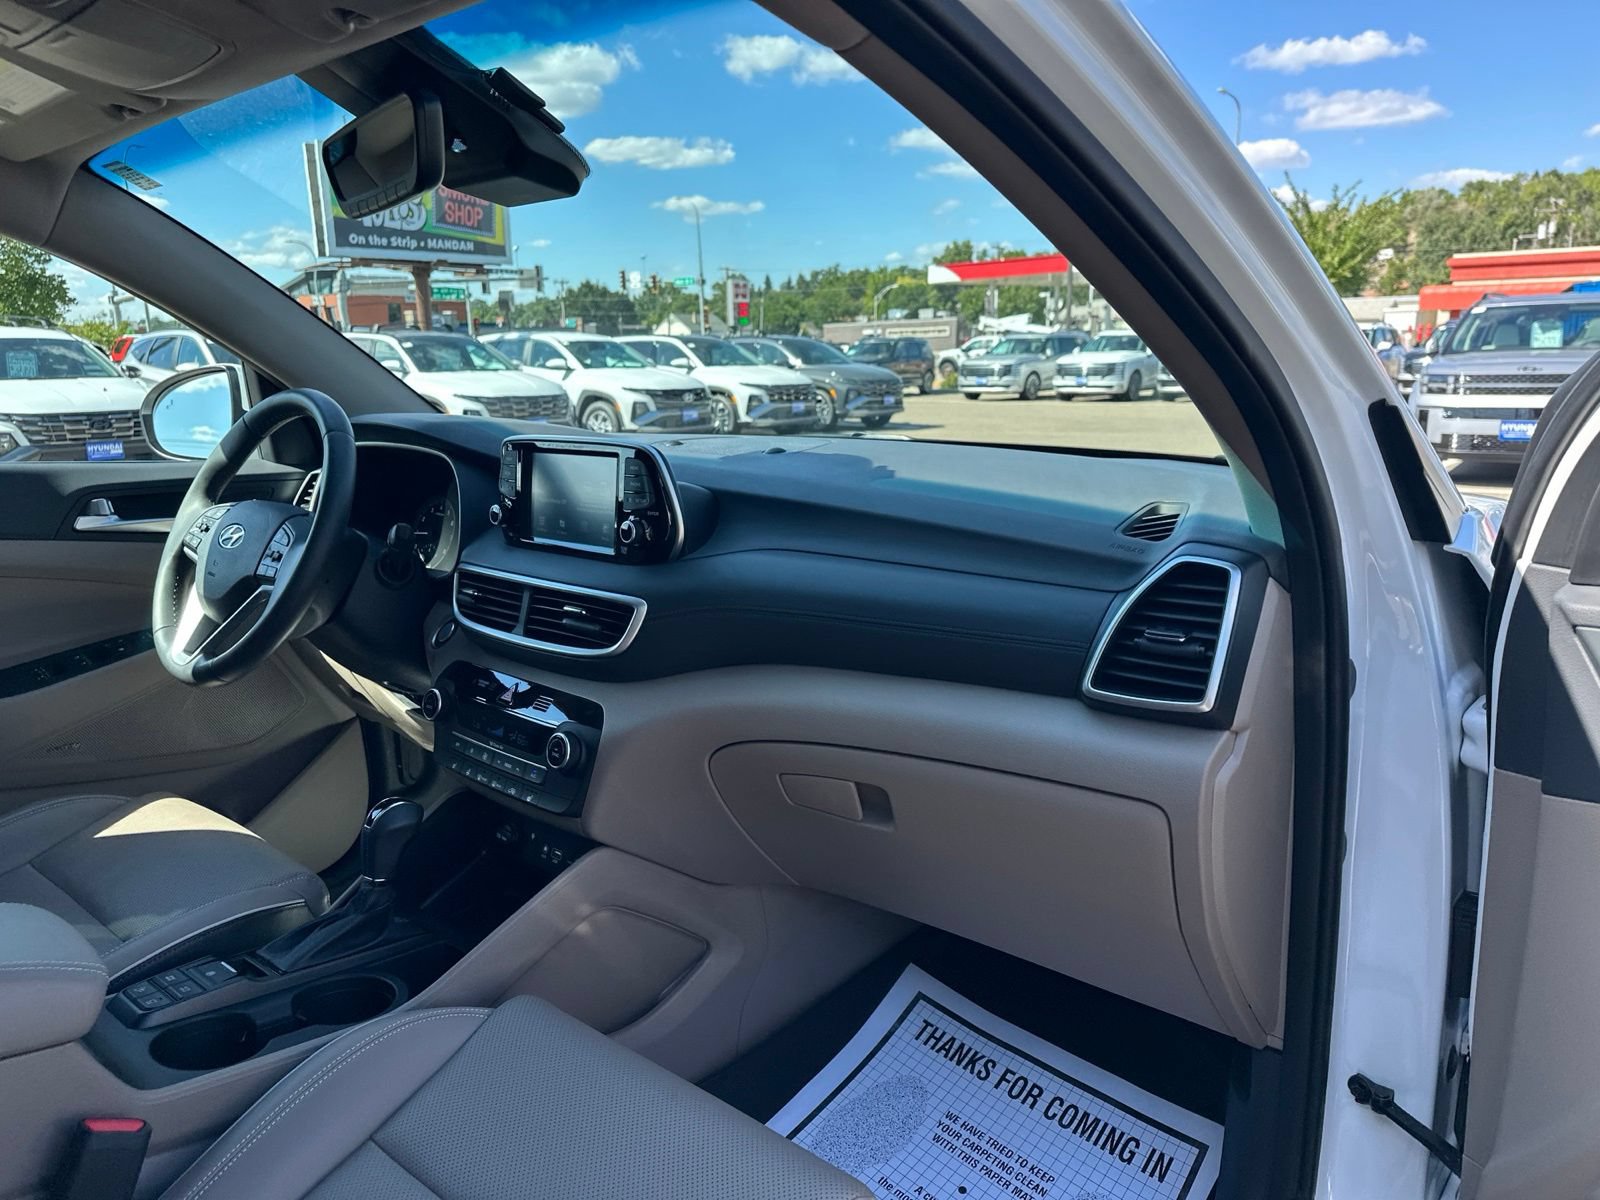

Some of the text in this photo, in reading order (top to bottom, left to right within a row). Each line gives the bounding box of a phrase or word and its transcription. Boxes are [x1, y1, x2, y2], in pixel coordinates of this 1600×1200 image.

[444, 202, 485, 228] SHOP
[348, 233, 474, 251] On the Strip MANDAN
[914, 1019, 1175, 1184] THANKS FOR COMING IN
[931, 1132, 957, 1155] WITH
[956, 1149, 979, 1170] THIS
[978, 1163, 1011, 1191] PAPER
[936, 1119, 1050, 1198] YOUR CARPETING CLEAN
[945, 1110, 1056, 1184] WE HAVE TRIED TO KEEP
[877, 1176, 894, 1191] the
[914, 1186, 924, 1196] A
